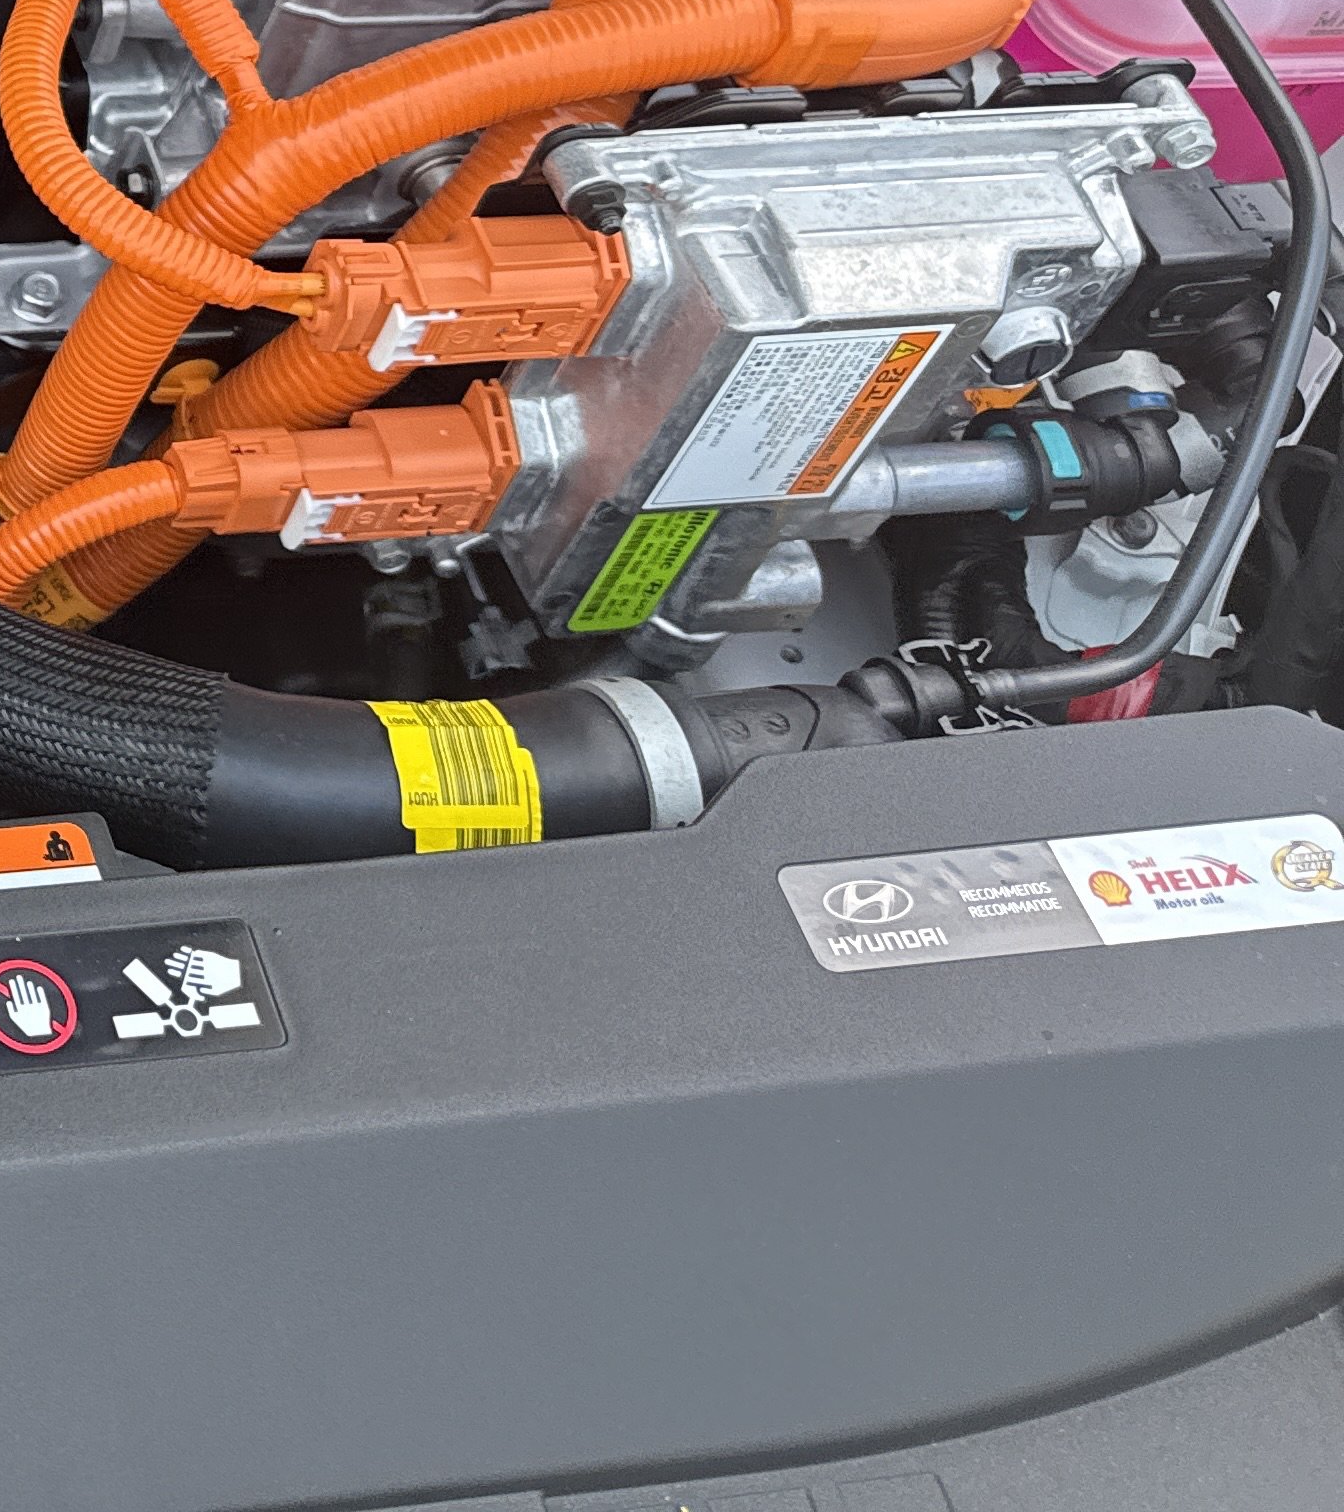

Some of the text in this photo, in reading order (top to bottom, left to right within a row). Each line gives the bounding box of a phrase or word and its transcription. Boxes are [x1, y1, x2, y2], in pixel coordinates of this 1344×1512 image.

[859, 367, 909, 402] 경고
[847, 406, 883, 439] WARNING
[1127, 856, 1157, 870] Shell
[1287, 849, 1335, 864] QUAKER
[1294, 860, 1332, 873] STATE
[1137, 864, 1252, 895] HELIX
[960, 882, 1052, 904] RECOMMENDS
[1154, 892, 1225, 911] Motor oils
[968, 897, 1062, 919] RECOMMANDE
[828, 927, 950, 957] HYUNDAI
